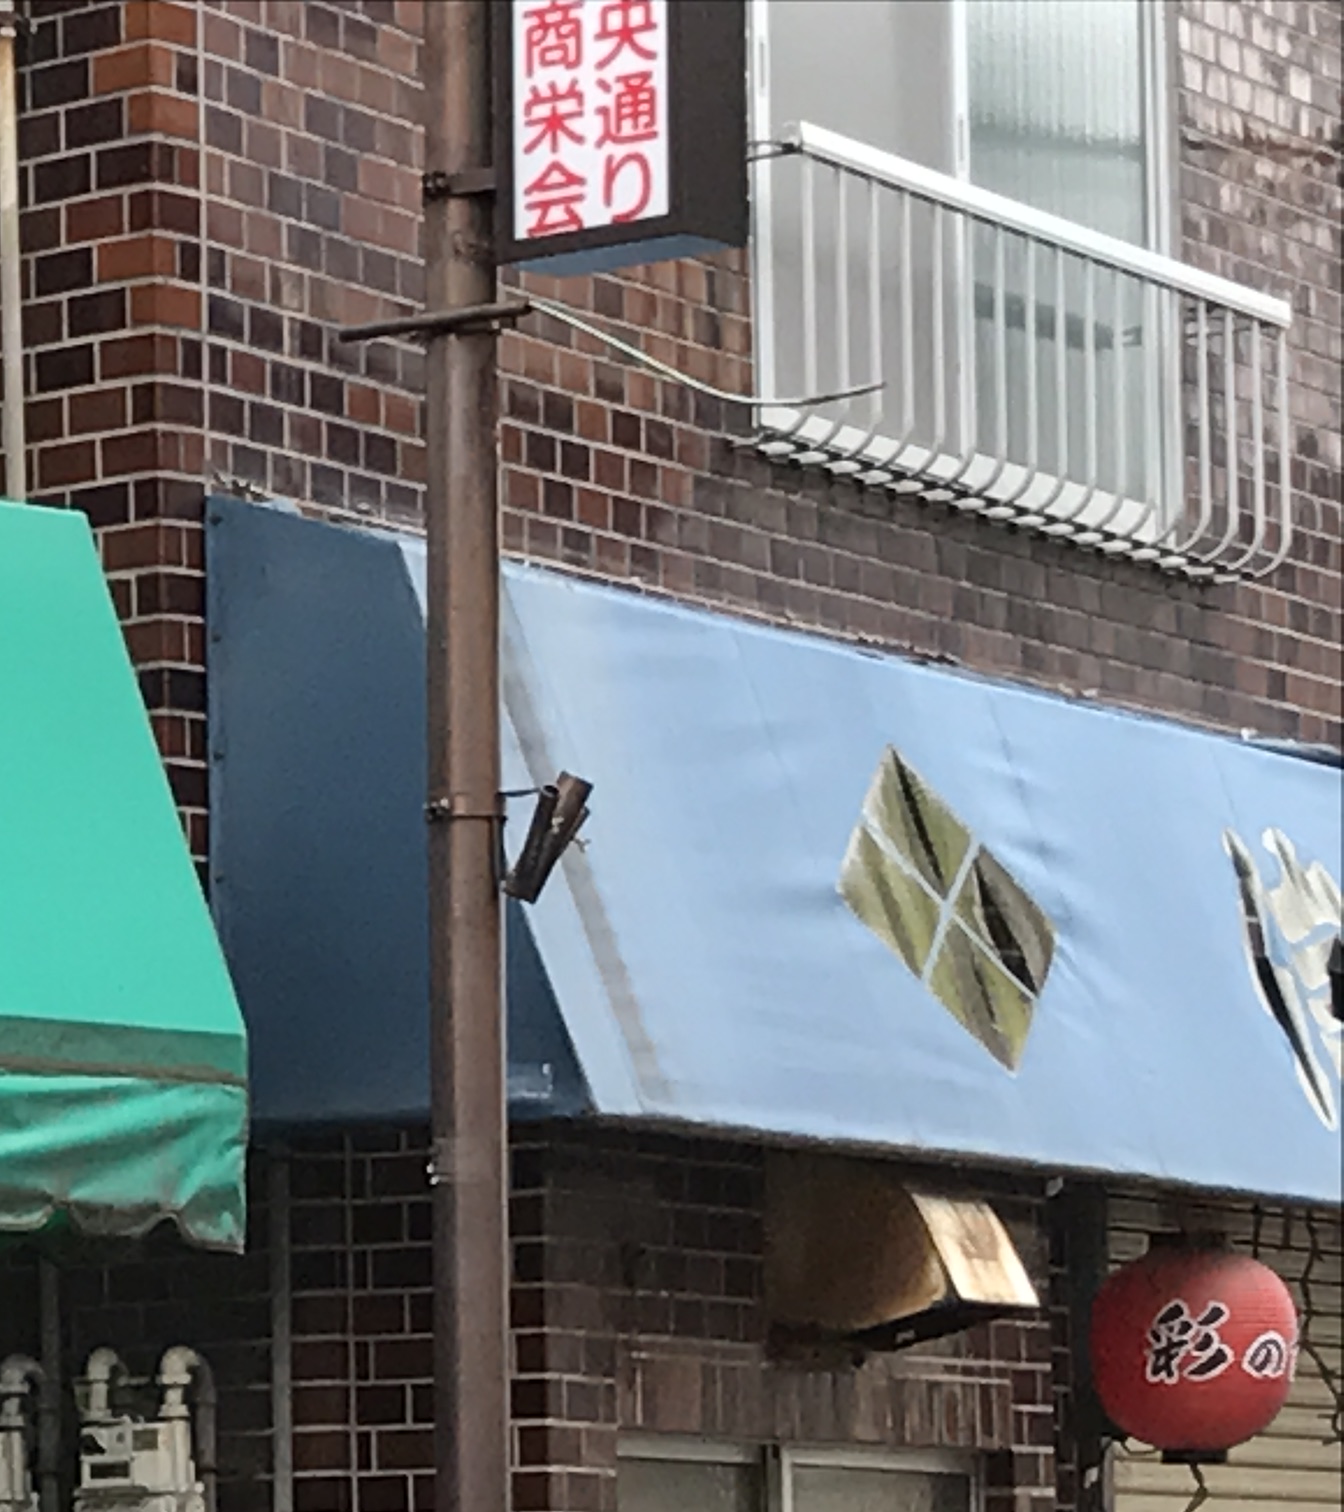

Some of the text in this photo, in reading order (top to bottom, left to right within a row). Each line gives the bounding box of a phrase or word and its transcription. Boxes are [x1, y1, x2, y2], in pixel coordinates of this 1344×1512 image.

[523, 0, 587, 238] 商栄会
[594, 0, 658, 224] 央通り
[1145, 1299, 1297, 1385] 彩の
